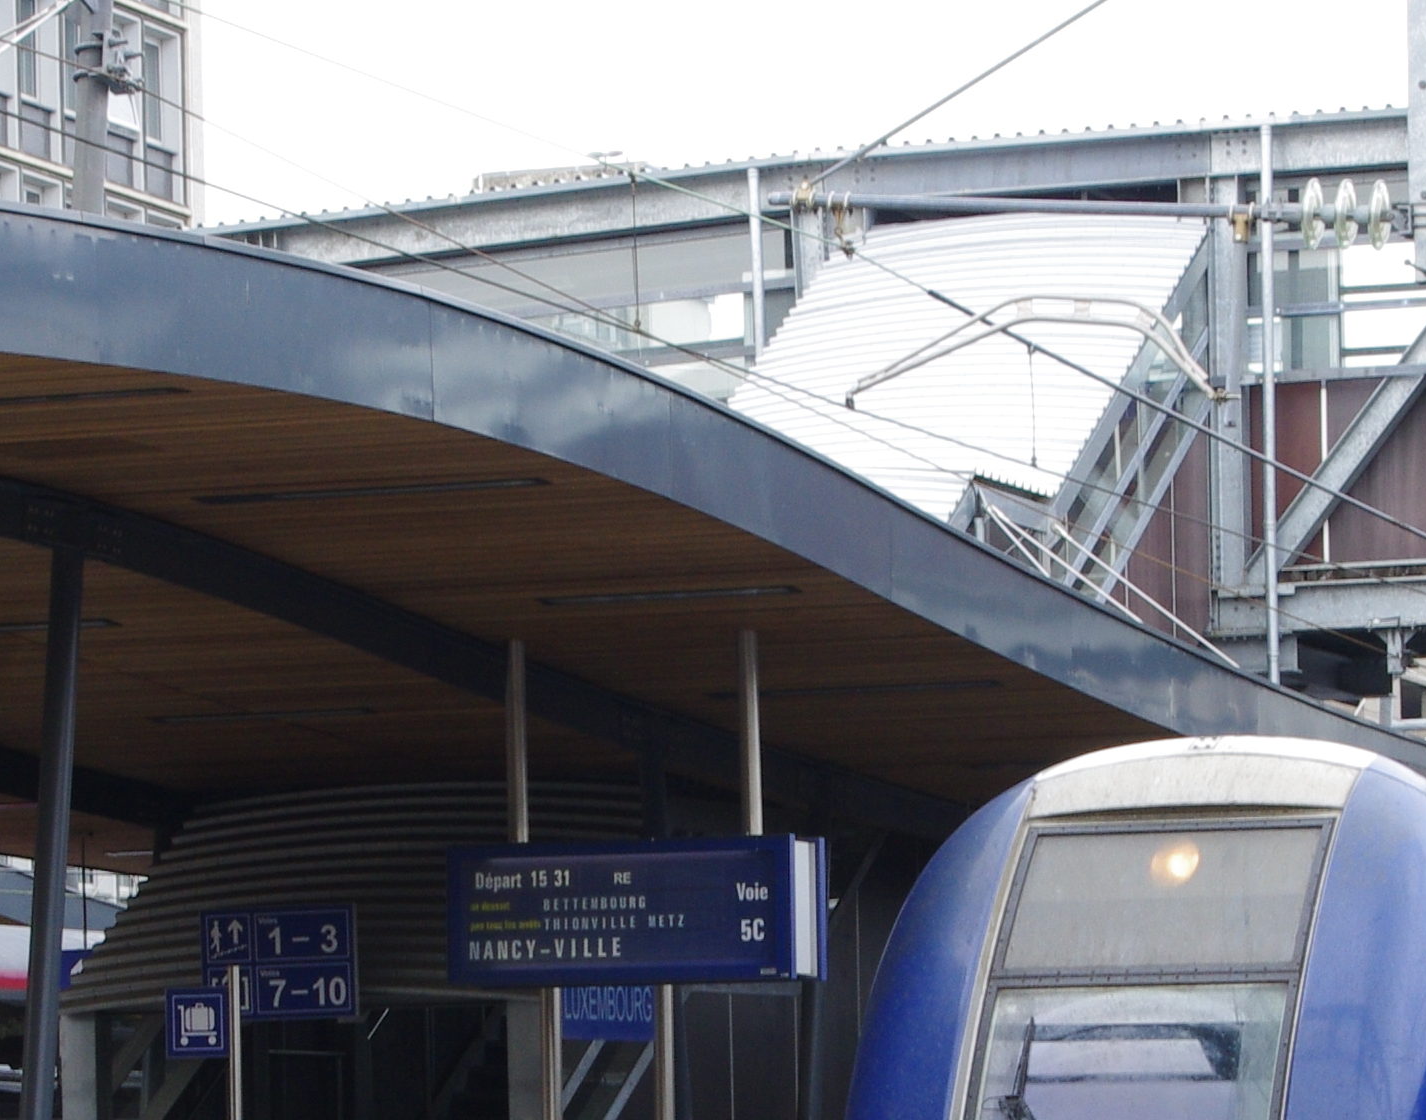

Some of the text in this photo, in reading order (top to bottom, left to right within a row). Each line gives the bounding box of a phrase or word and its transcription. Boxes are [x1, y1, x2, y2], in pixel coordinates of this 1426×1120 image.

[475, 868, 632, 892] Départ 15 31 RE
[736, 881, 769, 902] Voie
[543, 894, 647, 912] BETTEMBOURG
[543, 913, 686, 931] THIONVILLE METZ
[740, 917, 765, 943] 5C
[469, 936, 622, 961] NANCY-VILLE
[563, 985, 653, 1022] LUXEMBOURG
